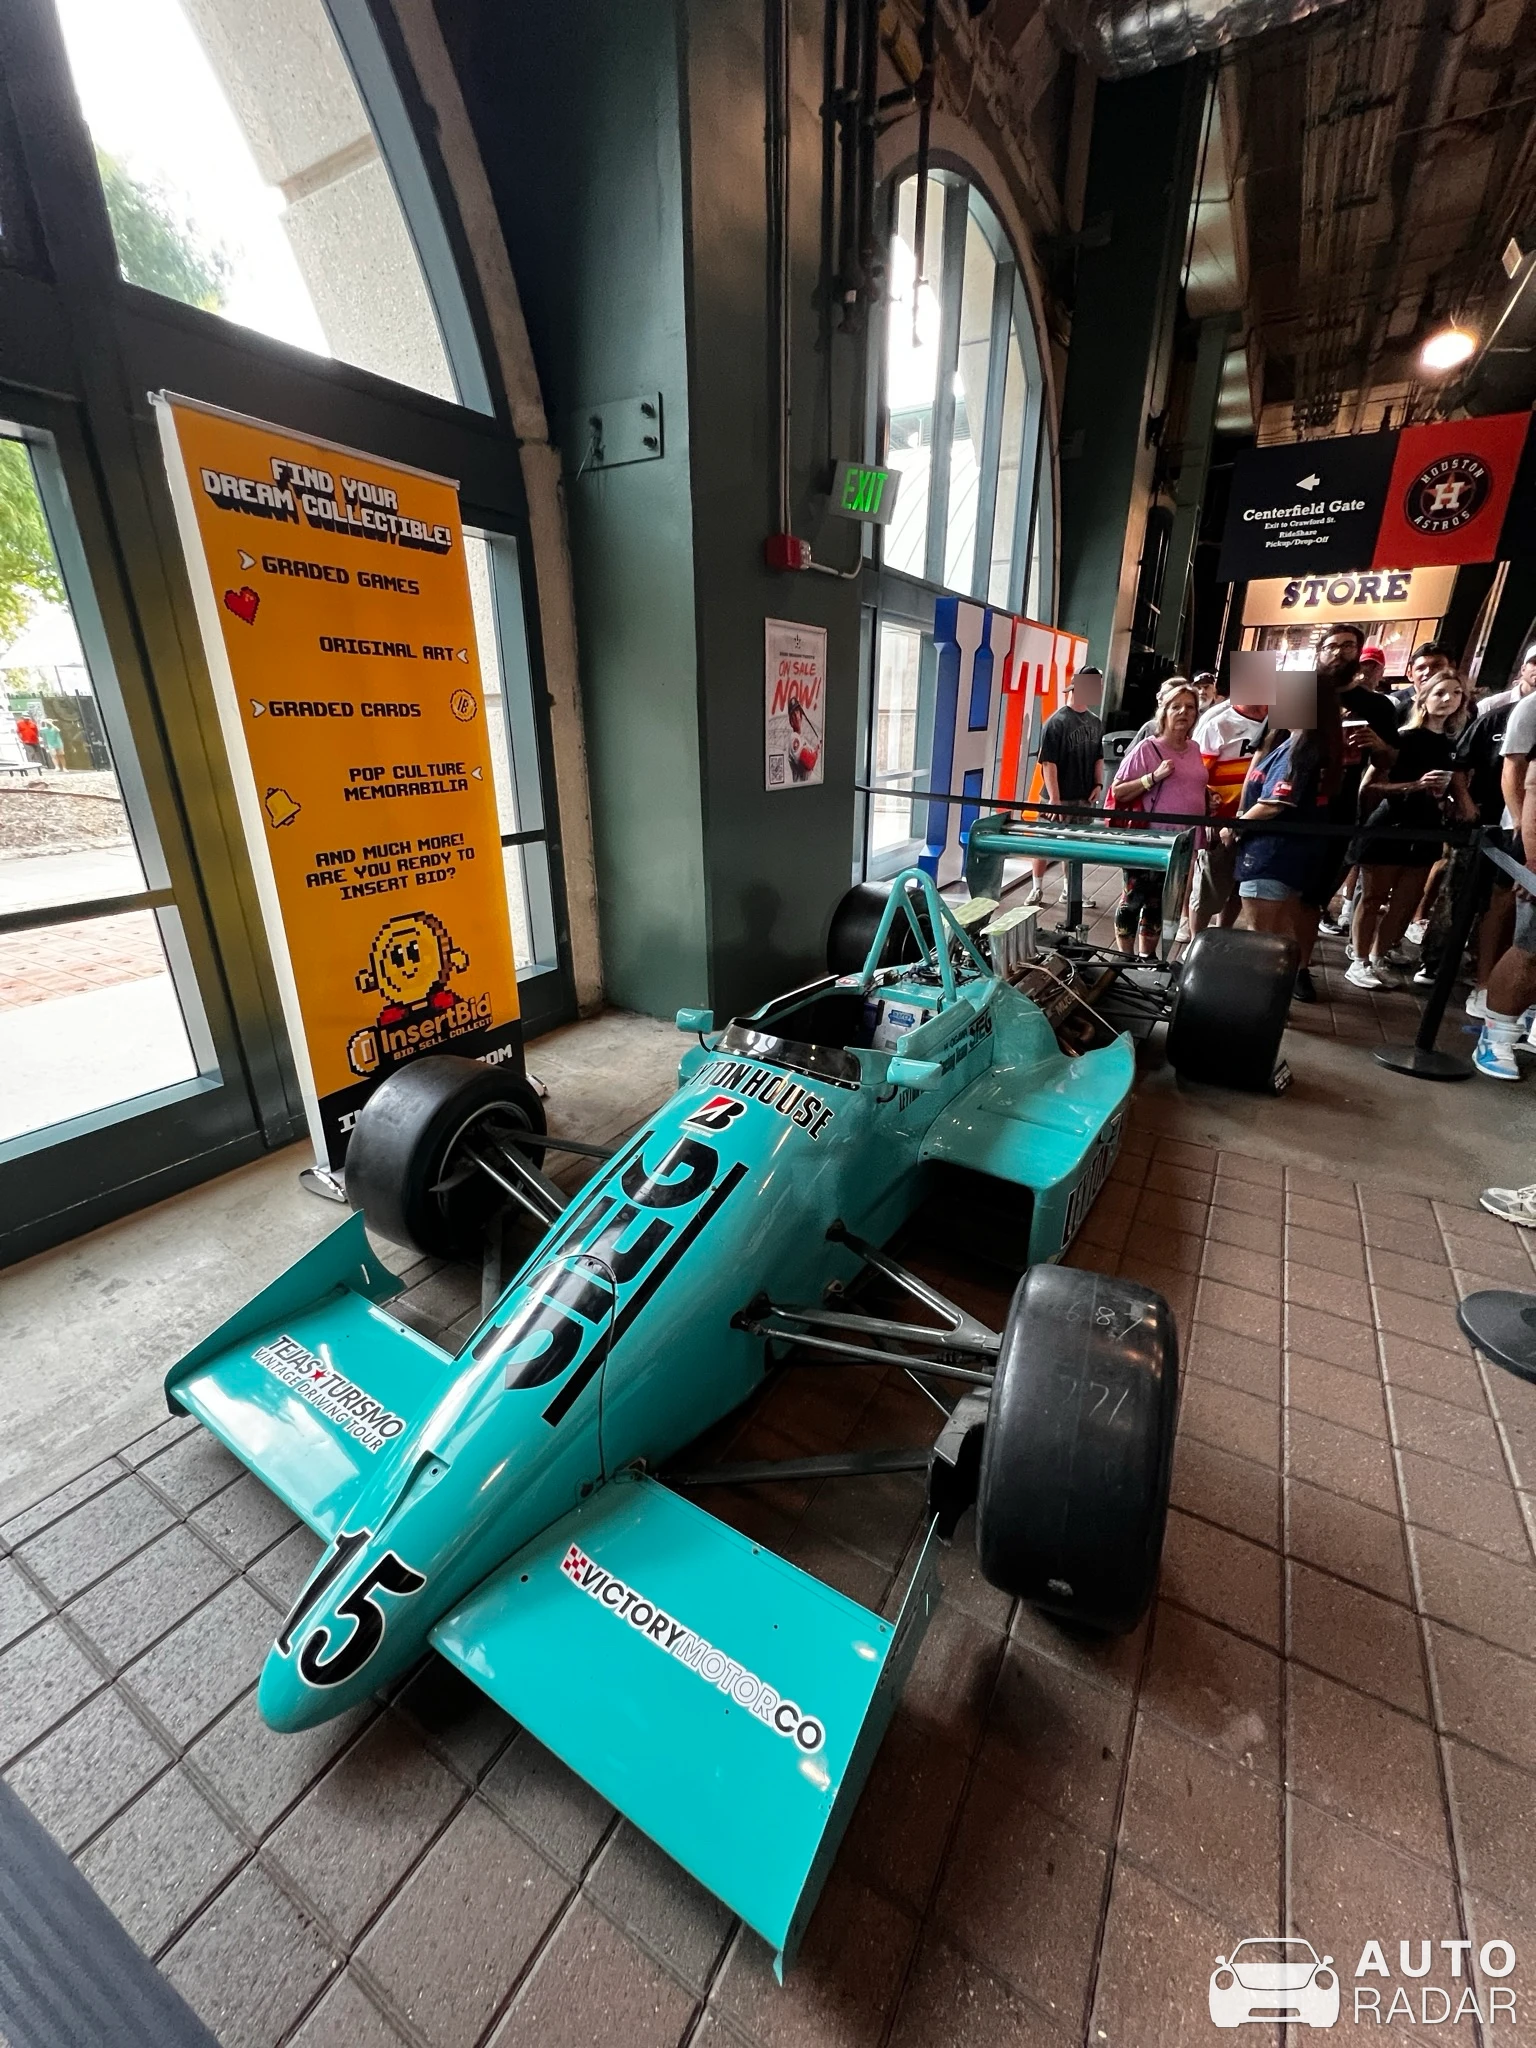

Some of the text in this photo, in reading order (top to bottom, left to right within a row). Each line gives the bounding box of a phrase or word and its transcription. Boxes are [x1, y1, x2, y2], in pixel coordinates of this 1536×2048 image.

[270, 458, 399, 511] FIND YOUR
[1421, 458, 1485, 485] HOUSTON
[842, 467, 889, 514] EXIT
[200, 468, 453, 550] DREAM COLLECTIBLE!
[1243, 499, 1366, 521] Centerfield Gate
[1264, 522, 1280, 530] Exit
[1289, 517, 1326, 527] Crawford
[1414, 509, 1471, 532] ASTROS
[261, 556, 420, 595] GRADED GAMES
[1280, 573, 1412, 609] STORE
[319, 637, 454, 661] ORIGINAL ART
[779, 660, 816, 677] ON SALE
[269, 701, 421, 717] GRADED CARDS
[771, 677, 821, 714] NOW!
[343, 778, 468, 802] MEMORABILIA
[349, 762, 466, 783] POP CULTURE
[306, 847, 475, 888] ARE YOU READY TO
[315, 833, 464, 868] AND MUCH MORE!
[340, 867, 456, 901] INSERT BID?
[381, 992, 492, 1053] InsertBid
[254, 1348, 383, 1451] VINTAGE DRIVING TOUR
[268, 1336, 404, 1438] TEJAS TURISMO
[276, 1527, 427, 1688] 15
